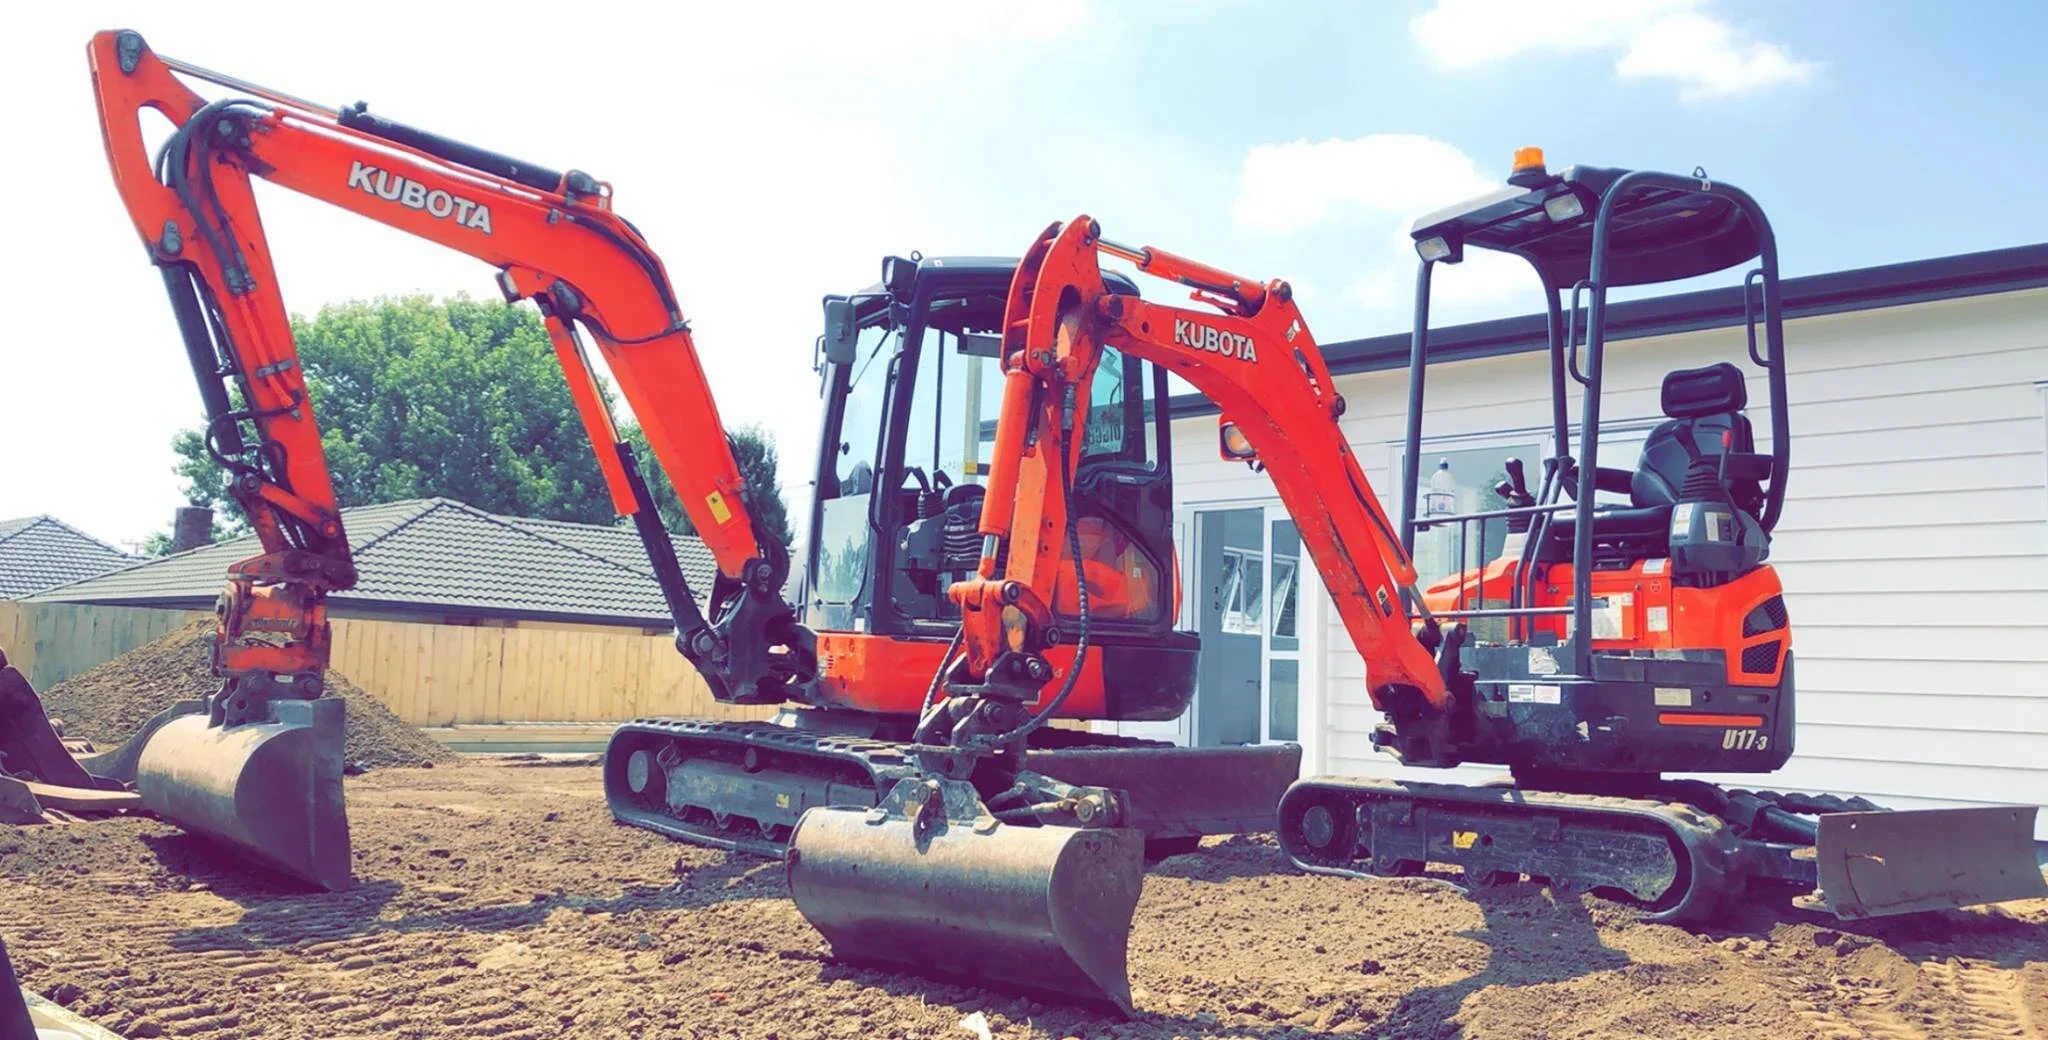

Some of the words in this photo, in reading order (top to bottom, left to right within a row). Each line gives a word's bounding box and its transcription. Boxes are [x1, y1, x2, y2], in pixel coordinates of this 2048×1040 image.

[348, 160, 493, 235] KUBOTA
[1174, 318, 1258, 363] KUBOTA
[1721, 729, 1769, 751] U17-3
